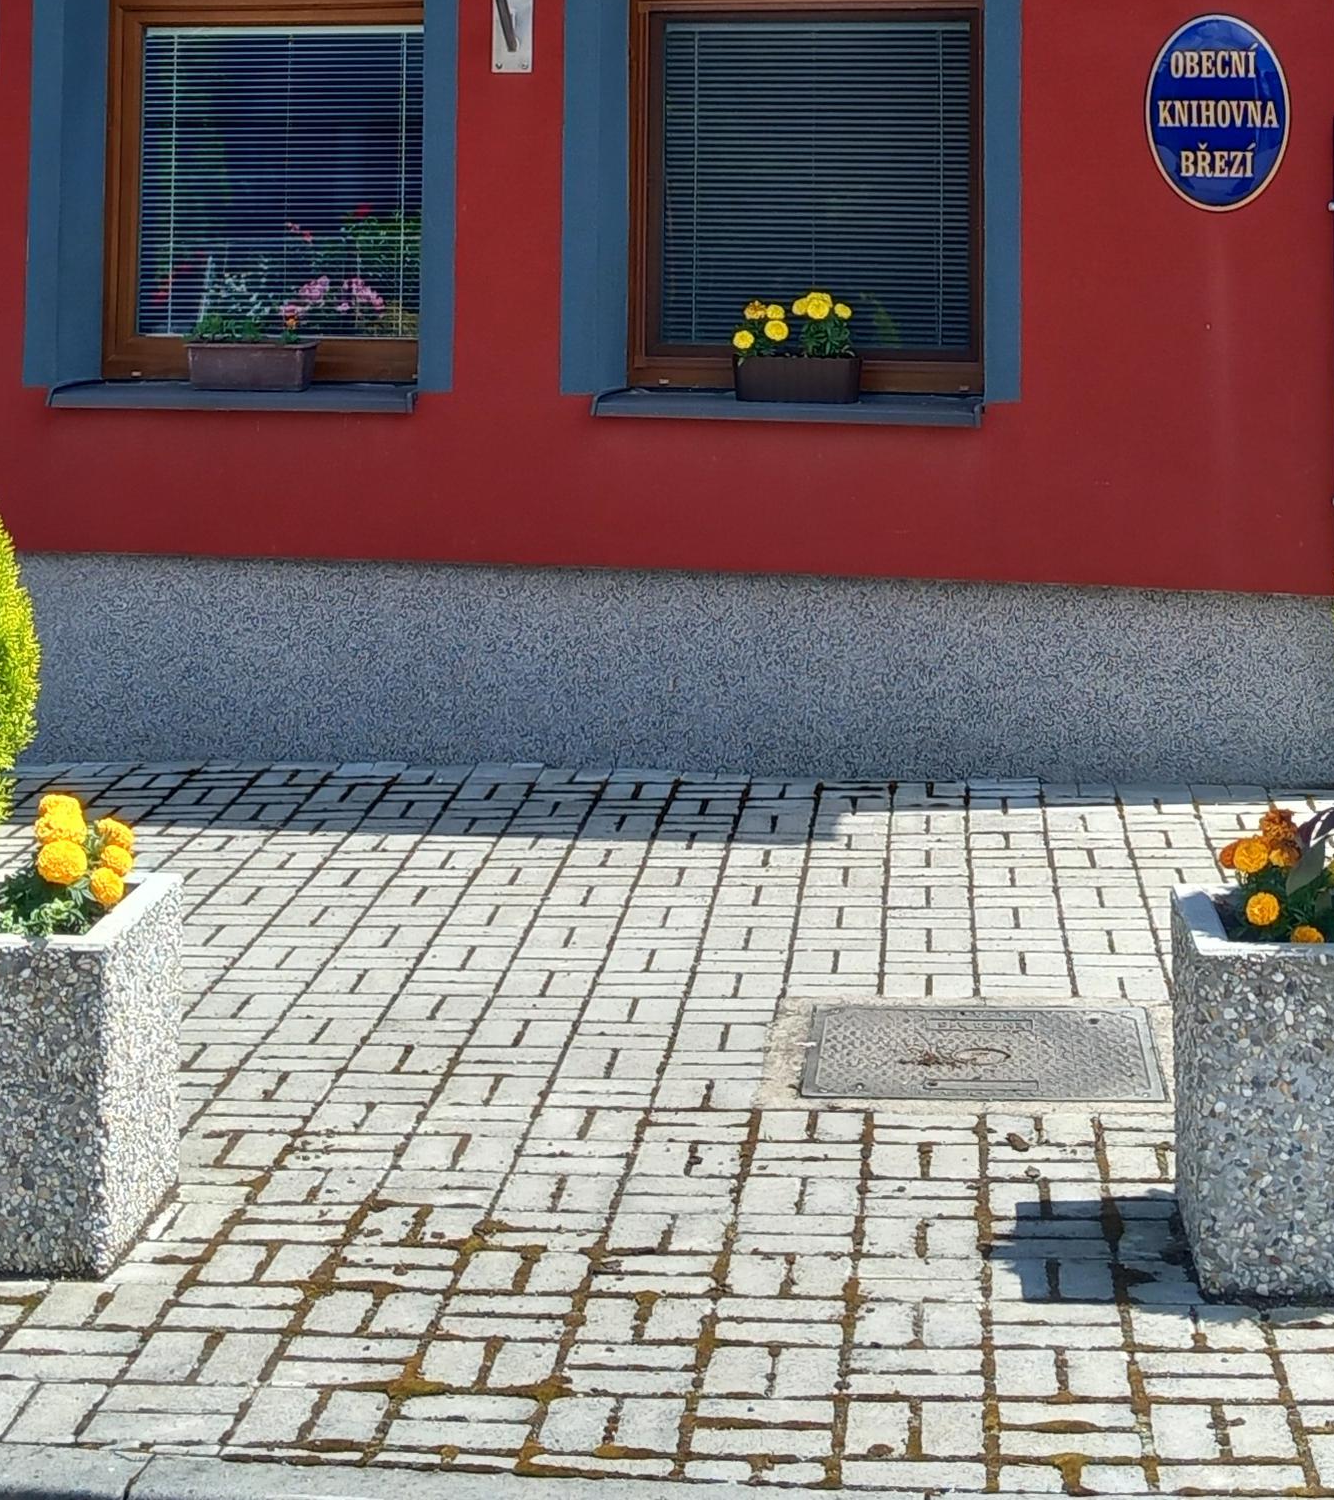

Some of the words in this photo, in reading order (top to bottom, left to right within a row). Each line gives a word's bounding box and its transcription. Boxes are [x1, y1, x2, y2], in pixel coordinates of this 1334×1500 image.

[1170, 42, 1259, 78] OBECNÍ
[1157, 100, 1280, 128] KNIHOVNA
[1180, 142, 1256, 178] BŘEZÍ
